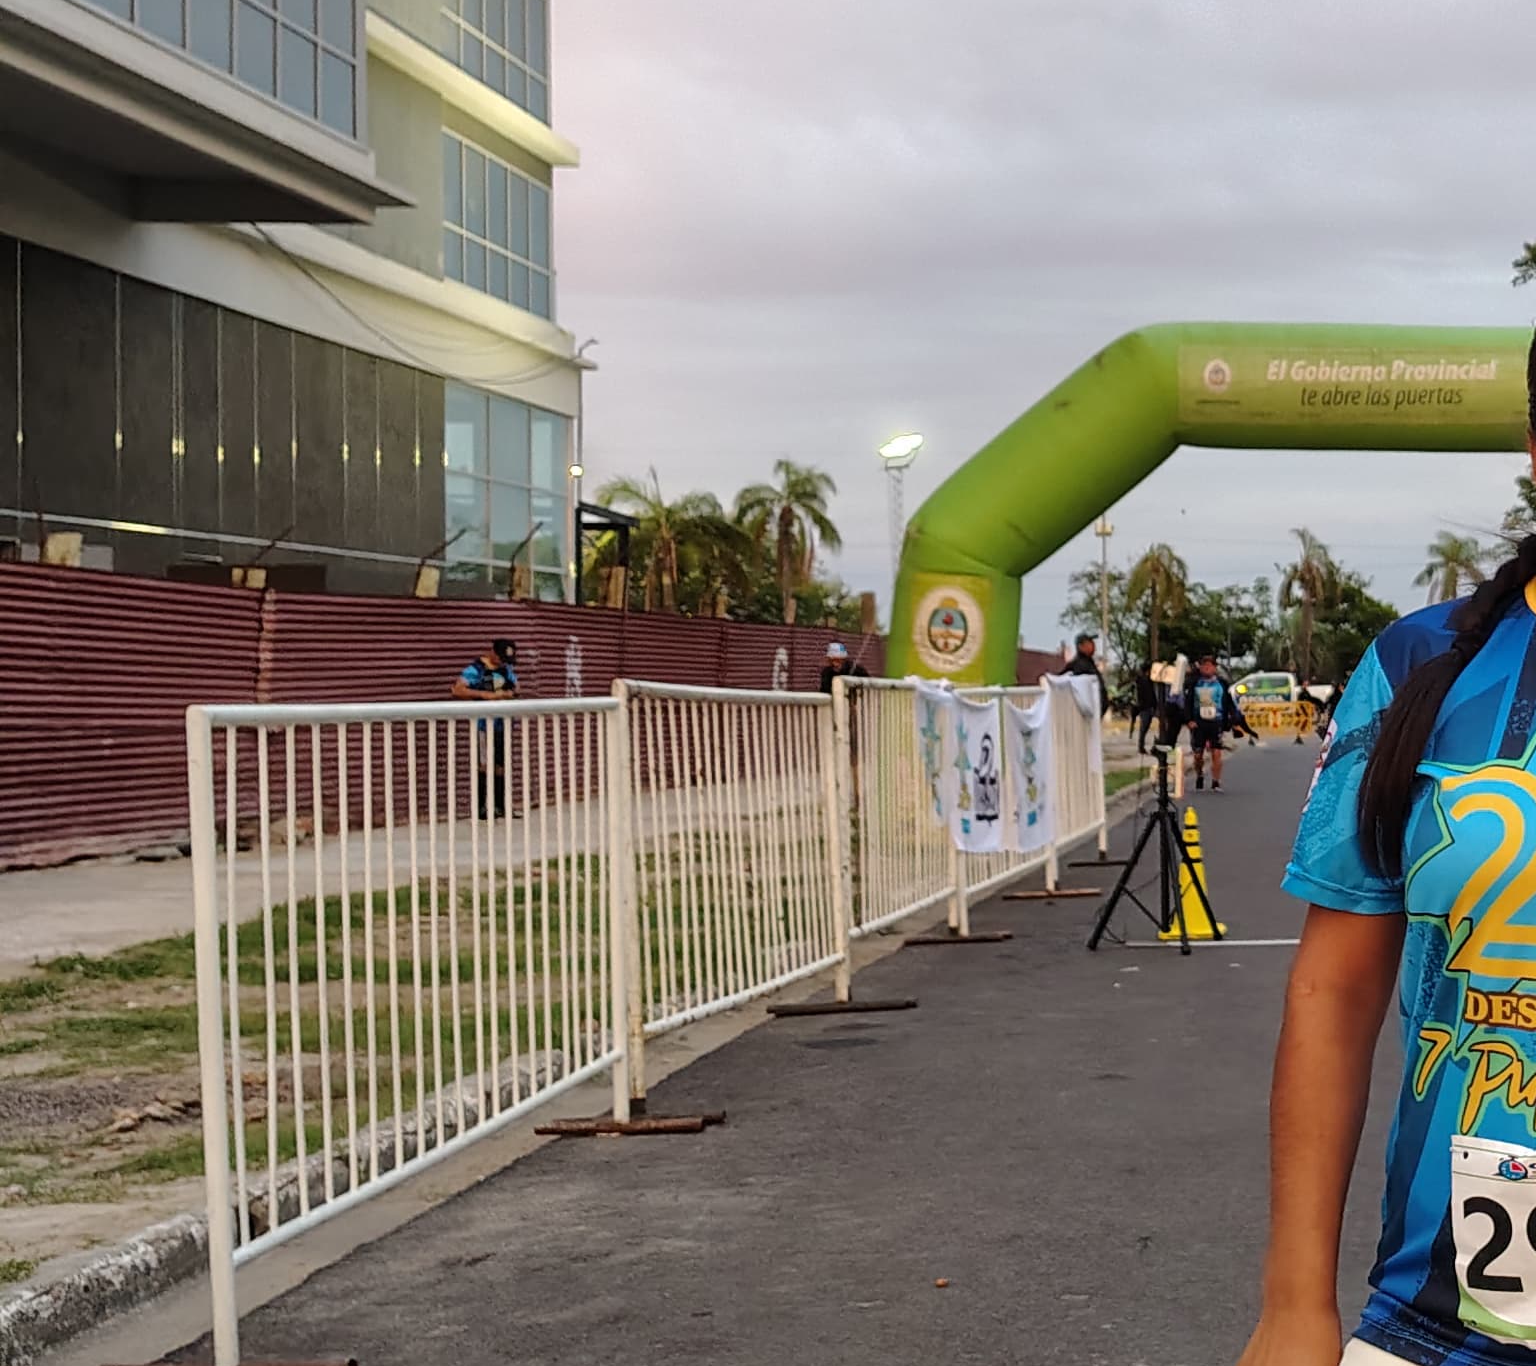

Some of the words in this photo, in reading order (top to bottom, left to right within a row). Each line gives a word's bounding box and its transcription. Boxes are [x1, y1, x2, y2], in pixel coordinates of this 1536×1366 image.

[1266, 359, 1286, 381] El
[1290, 358, 1385, 382] Gobierno
[1390, 357, 1498, 381] Provincial
[1301, 387, 1317, 406] te
[1321, 386, 1360, 406] abre
[1365, 385, 1391, 406] las
[1394, 387, 1464, 411] puertas
[1417, 1027, 1451, 1096] 7
